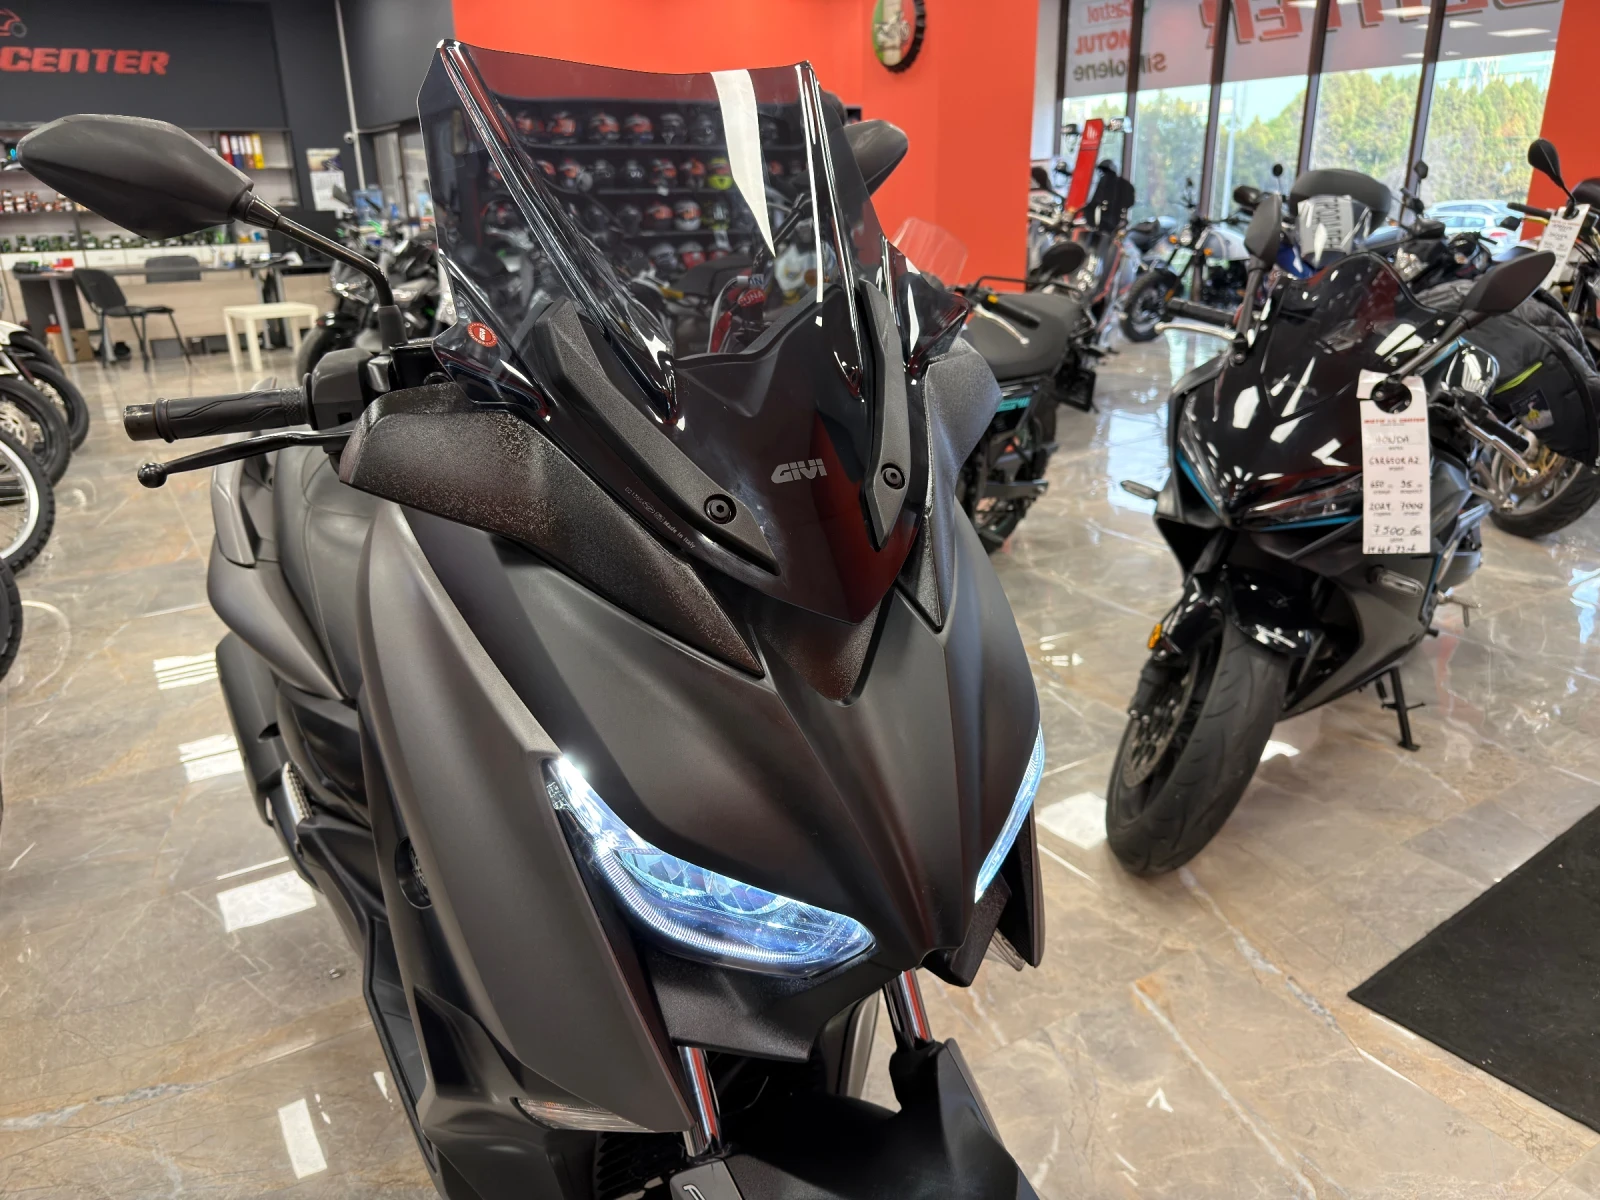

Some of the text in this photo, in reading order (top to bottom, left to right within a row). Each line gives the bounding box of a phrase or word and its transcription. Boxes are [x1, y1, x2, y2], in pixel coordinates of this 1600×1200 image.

[0, 46, 170, 75] CENTER
[771, 458, 827, 483] GIVI
[663, 520, 678, 533] Made
[683, 537, 696, 549] Italy
